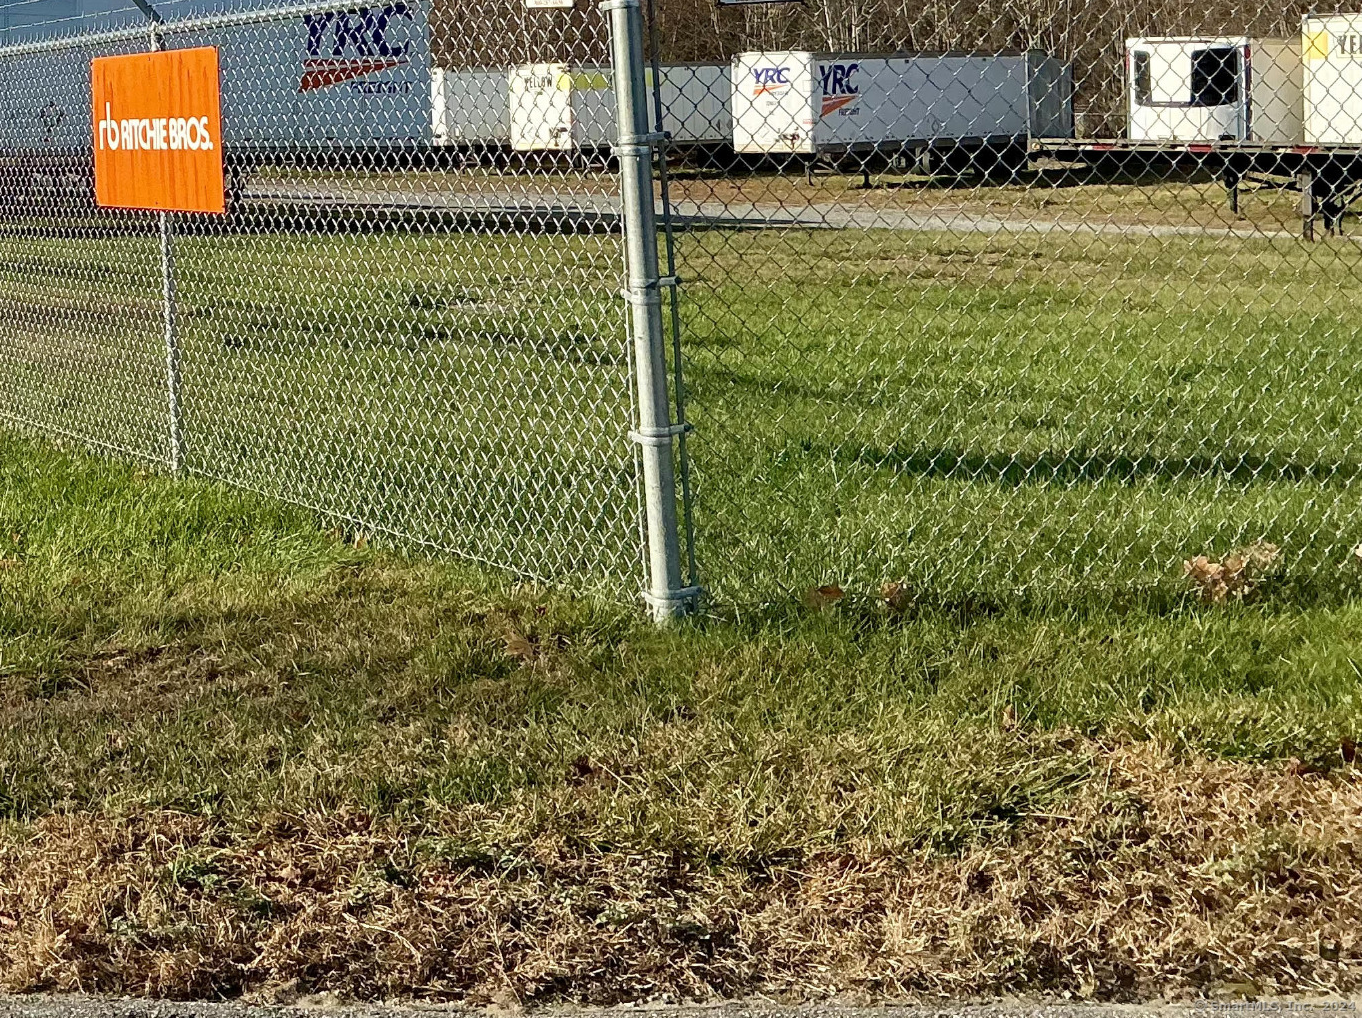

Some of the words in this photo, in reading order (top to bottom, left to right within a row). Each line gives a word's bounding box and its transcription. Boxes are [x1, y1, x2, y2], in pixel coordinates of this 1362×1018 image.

[302, 3, 414, 57] YRC
[524, 75, 553, 89] YELLOW
[753, 67, 790, 85] YRC
[819, 63, 860, 95] YRC
[121, 117, 168, 150] RITCHIE
[169, 116, 214, 151] BROS.
